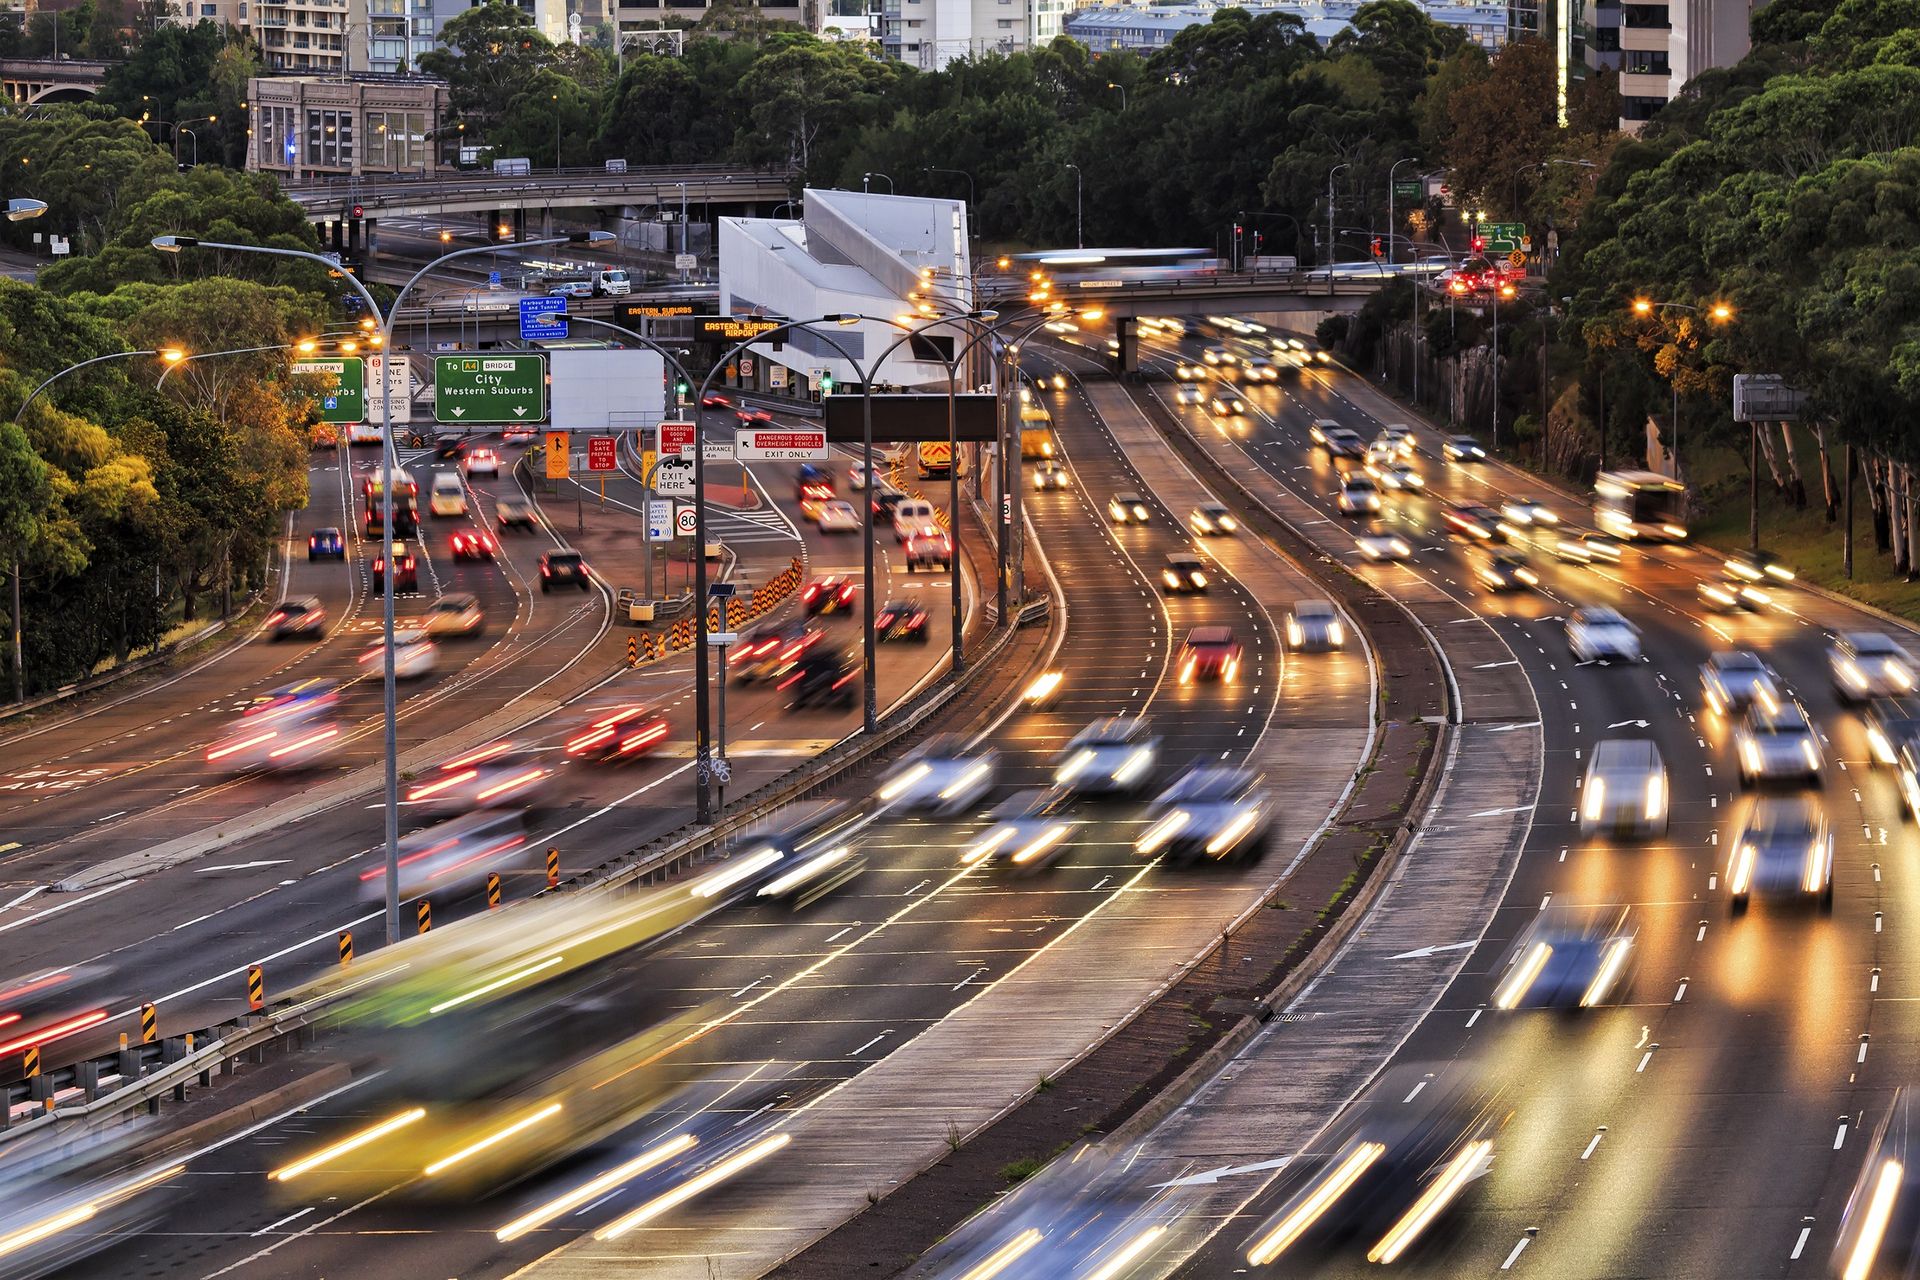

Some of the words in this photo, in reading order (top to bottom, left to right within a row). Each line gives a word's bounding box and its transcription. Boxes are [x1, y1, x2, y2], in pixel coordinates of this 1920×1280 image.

[743, 322, 779, 330] SUBURBS
[446, 362, 458, 370] To
[476, 374, 502, 386] City
[444, 387, 485, 395] Western
[491, 387, 533, 395] Suburbs
[681, 515, 696, 526] 80
[0, 780, 88, 790] ANE
